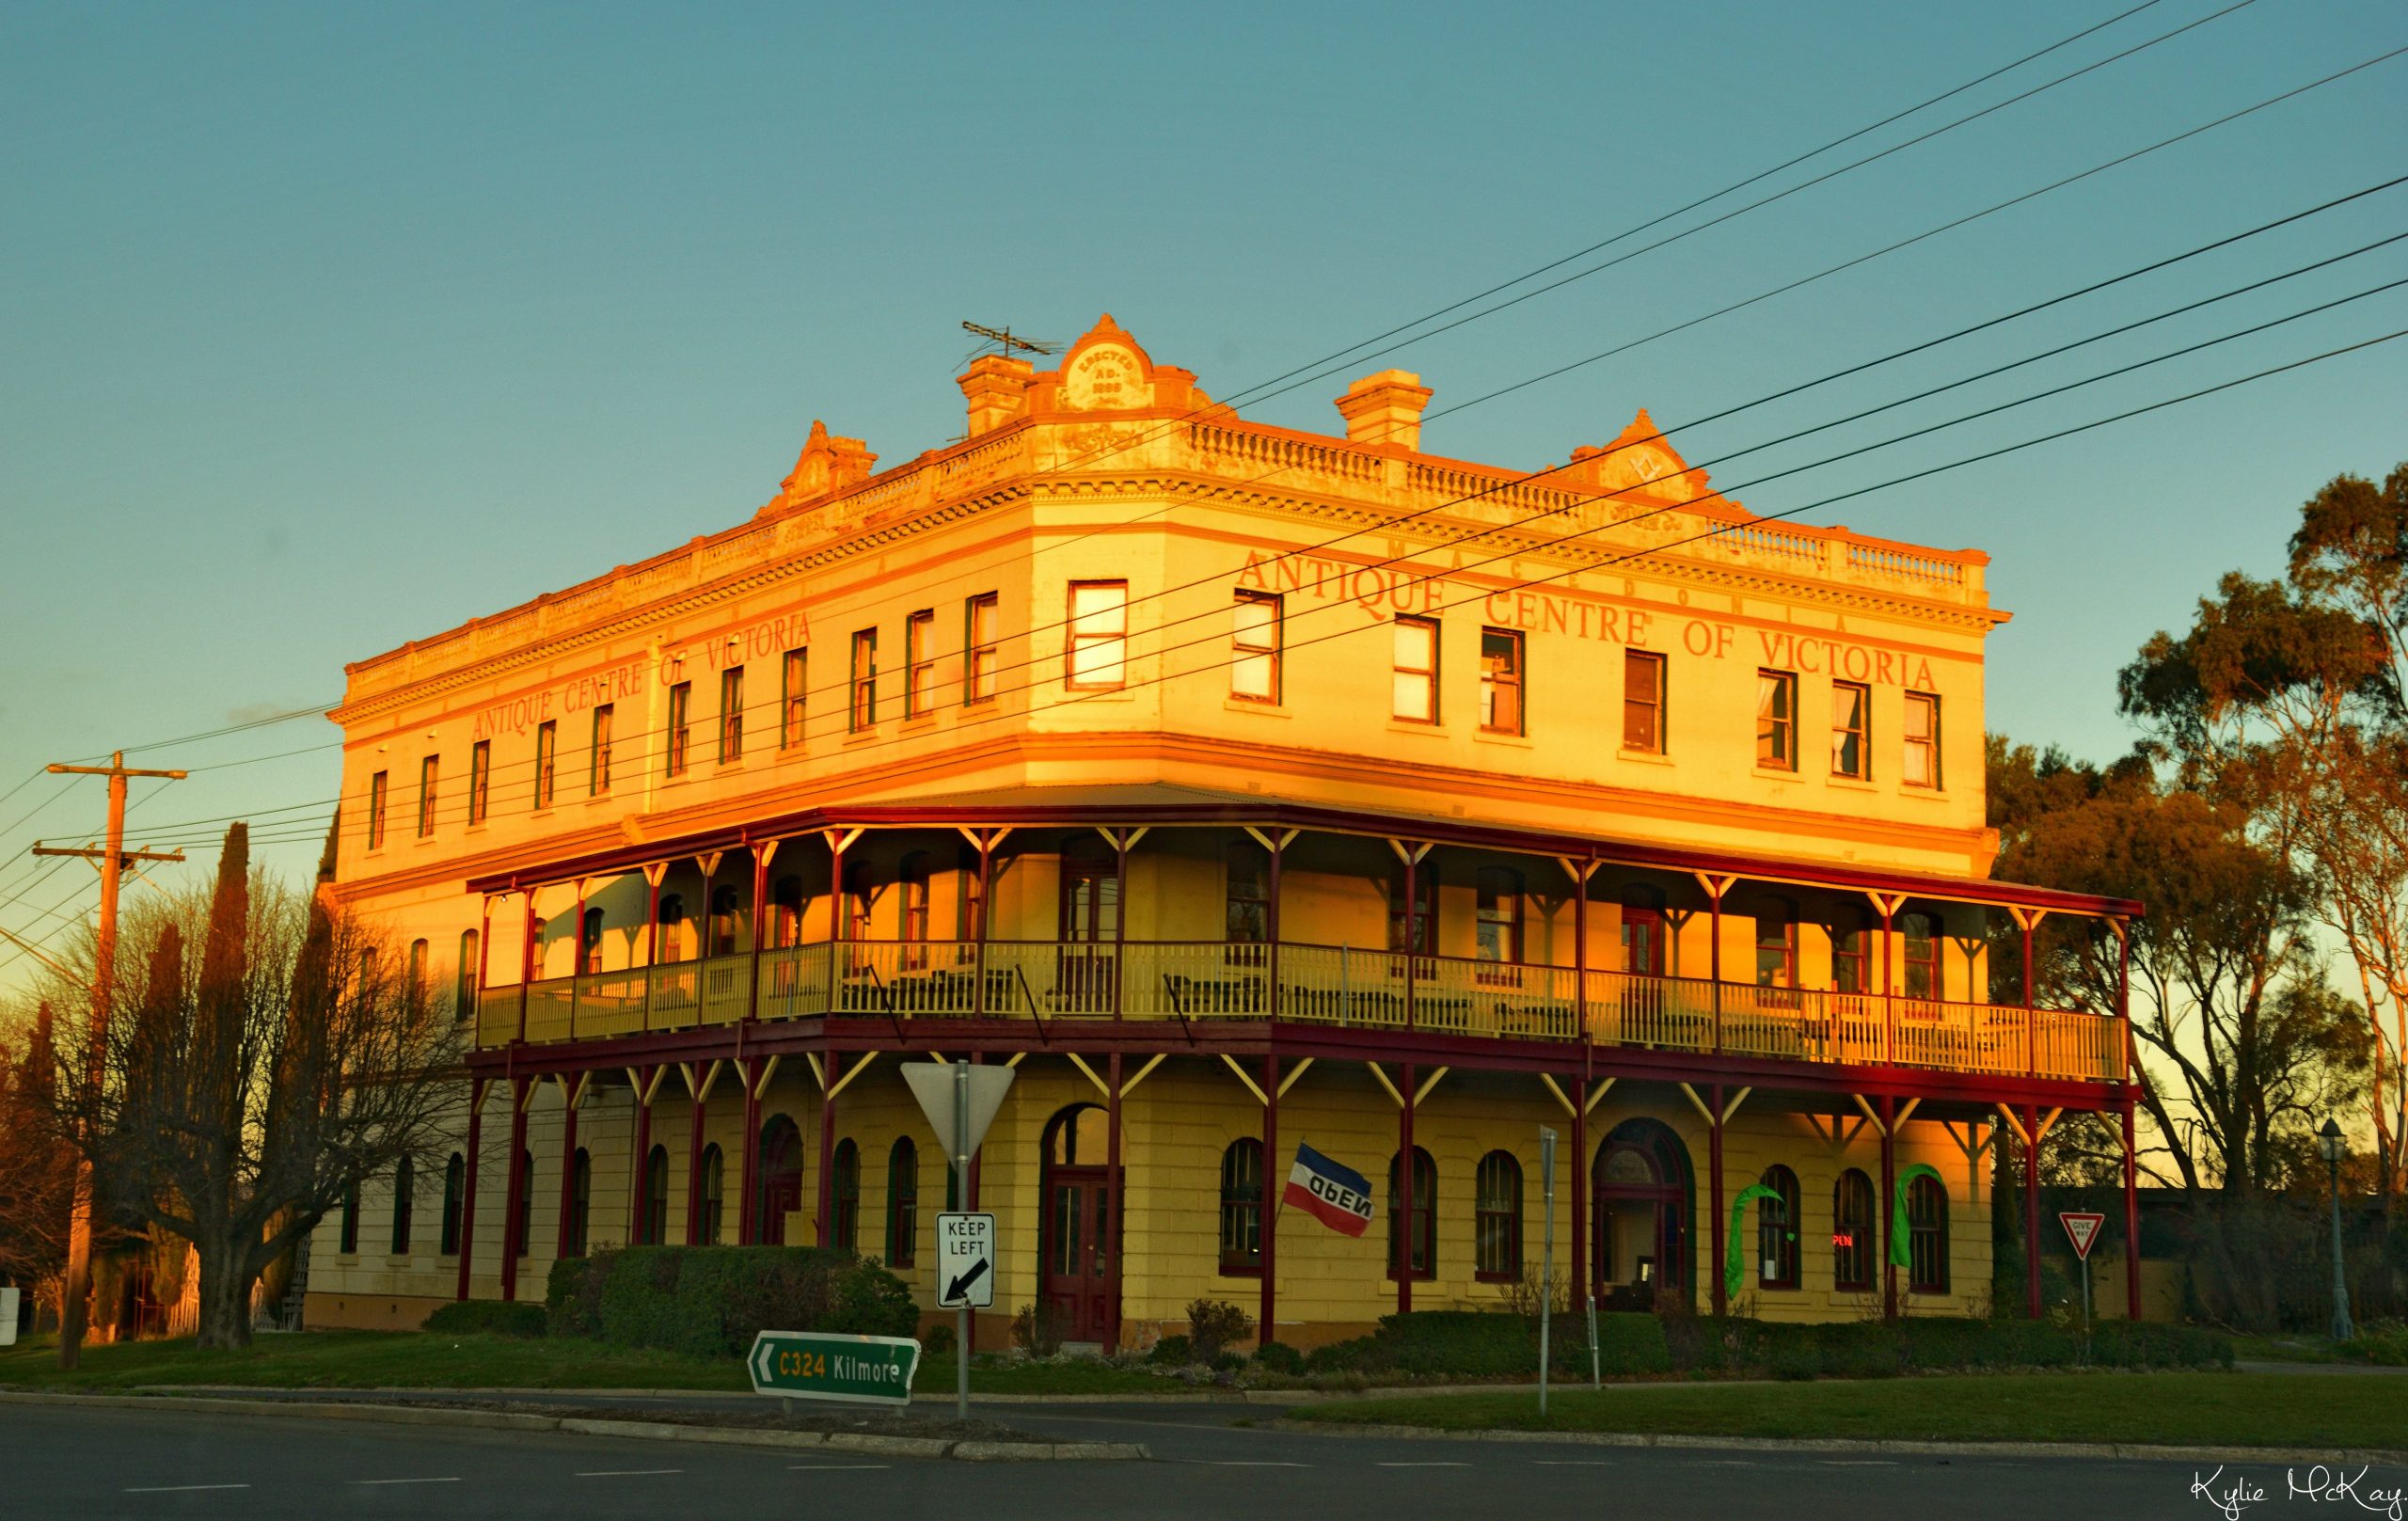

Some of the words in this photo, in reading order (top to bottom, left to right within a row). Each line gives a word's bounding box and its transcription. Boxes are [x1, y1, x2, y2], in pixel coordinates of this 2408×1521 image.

[1079, 351, 1133, 372] ERECTED
[1235, 549, 1446, 621] ANTIQUE
[1485, 589, 1648, 647] CENTRE
[1683, 620, 1735, 659] OF
[1757, 630, 1938, 692] VICTORIA
[471, 690, 552, 742] ANTIQUE
[564, 662, 643, 714] CENTRE
[659, 648, 689, 687] OF
[705, 611, 813, 673] VICTORIA
[948, 1223, 986, 1236] KEEP
[2072, 1221, 2092, 1229] GIVE
[950, 1241, 985, 1255] LEFT
[779, 1350, 826, 1378] C324
[833, 1355, 900, 1384] Kilmore
